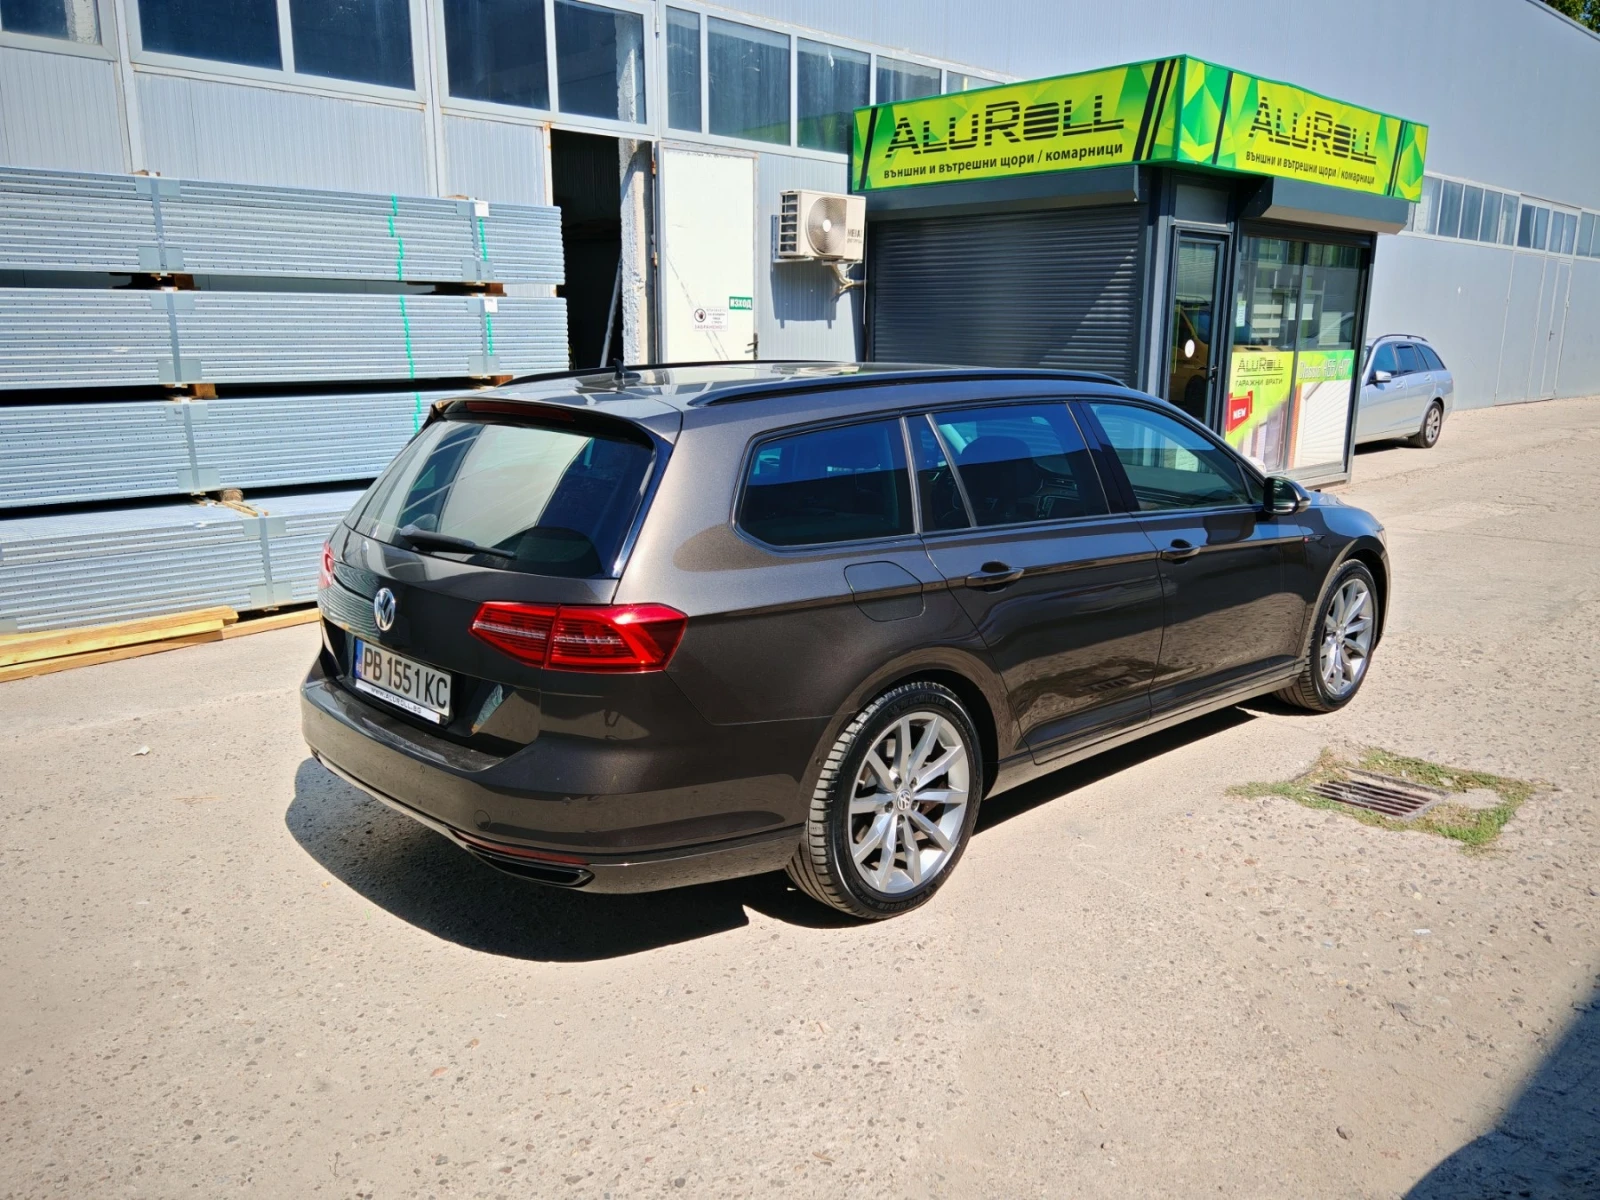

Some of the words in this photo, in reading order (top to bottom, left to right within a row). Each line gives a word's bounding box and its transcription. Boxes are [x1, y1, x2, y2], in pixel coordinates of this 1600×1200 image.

[885, 95, 1124, 158] ALUROLL
[1248, 97, 1377, 165] ALUROLL
[884, 165, 926, 179] външни
[929, 164, 936, 173] и
[939, 157, 997, 174] вътрешни
[1001, 154, 1035, 169] щори
[1045, 143, 1123, 162] комарници
[1246, 151, 1276, 167] външни
[1283, 159, 1318, 175] вътрешни
[1318, 165, 1337, 178] щори
[1340, 169, 1375, 185] комарници
[730, 298, 752, 309] ИЗХОД
[1236, 379, 1263, 387] ГАРАЖНИ
[1265, 378, 1283, 386] ВРАТИ
[1232, 407, 1247, 421] NEW
[364, 647, 382, 682] PB
[387, 657, 421, 699] 1551
[425, 672, 448, 709] KC
